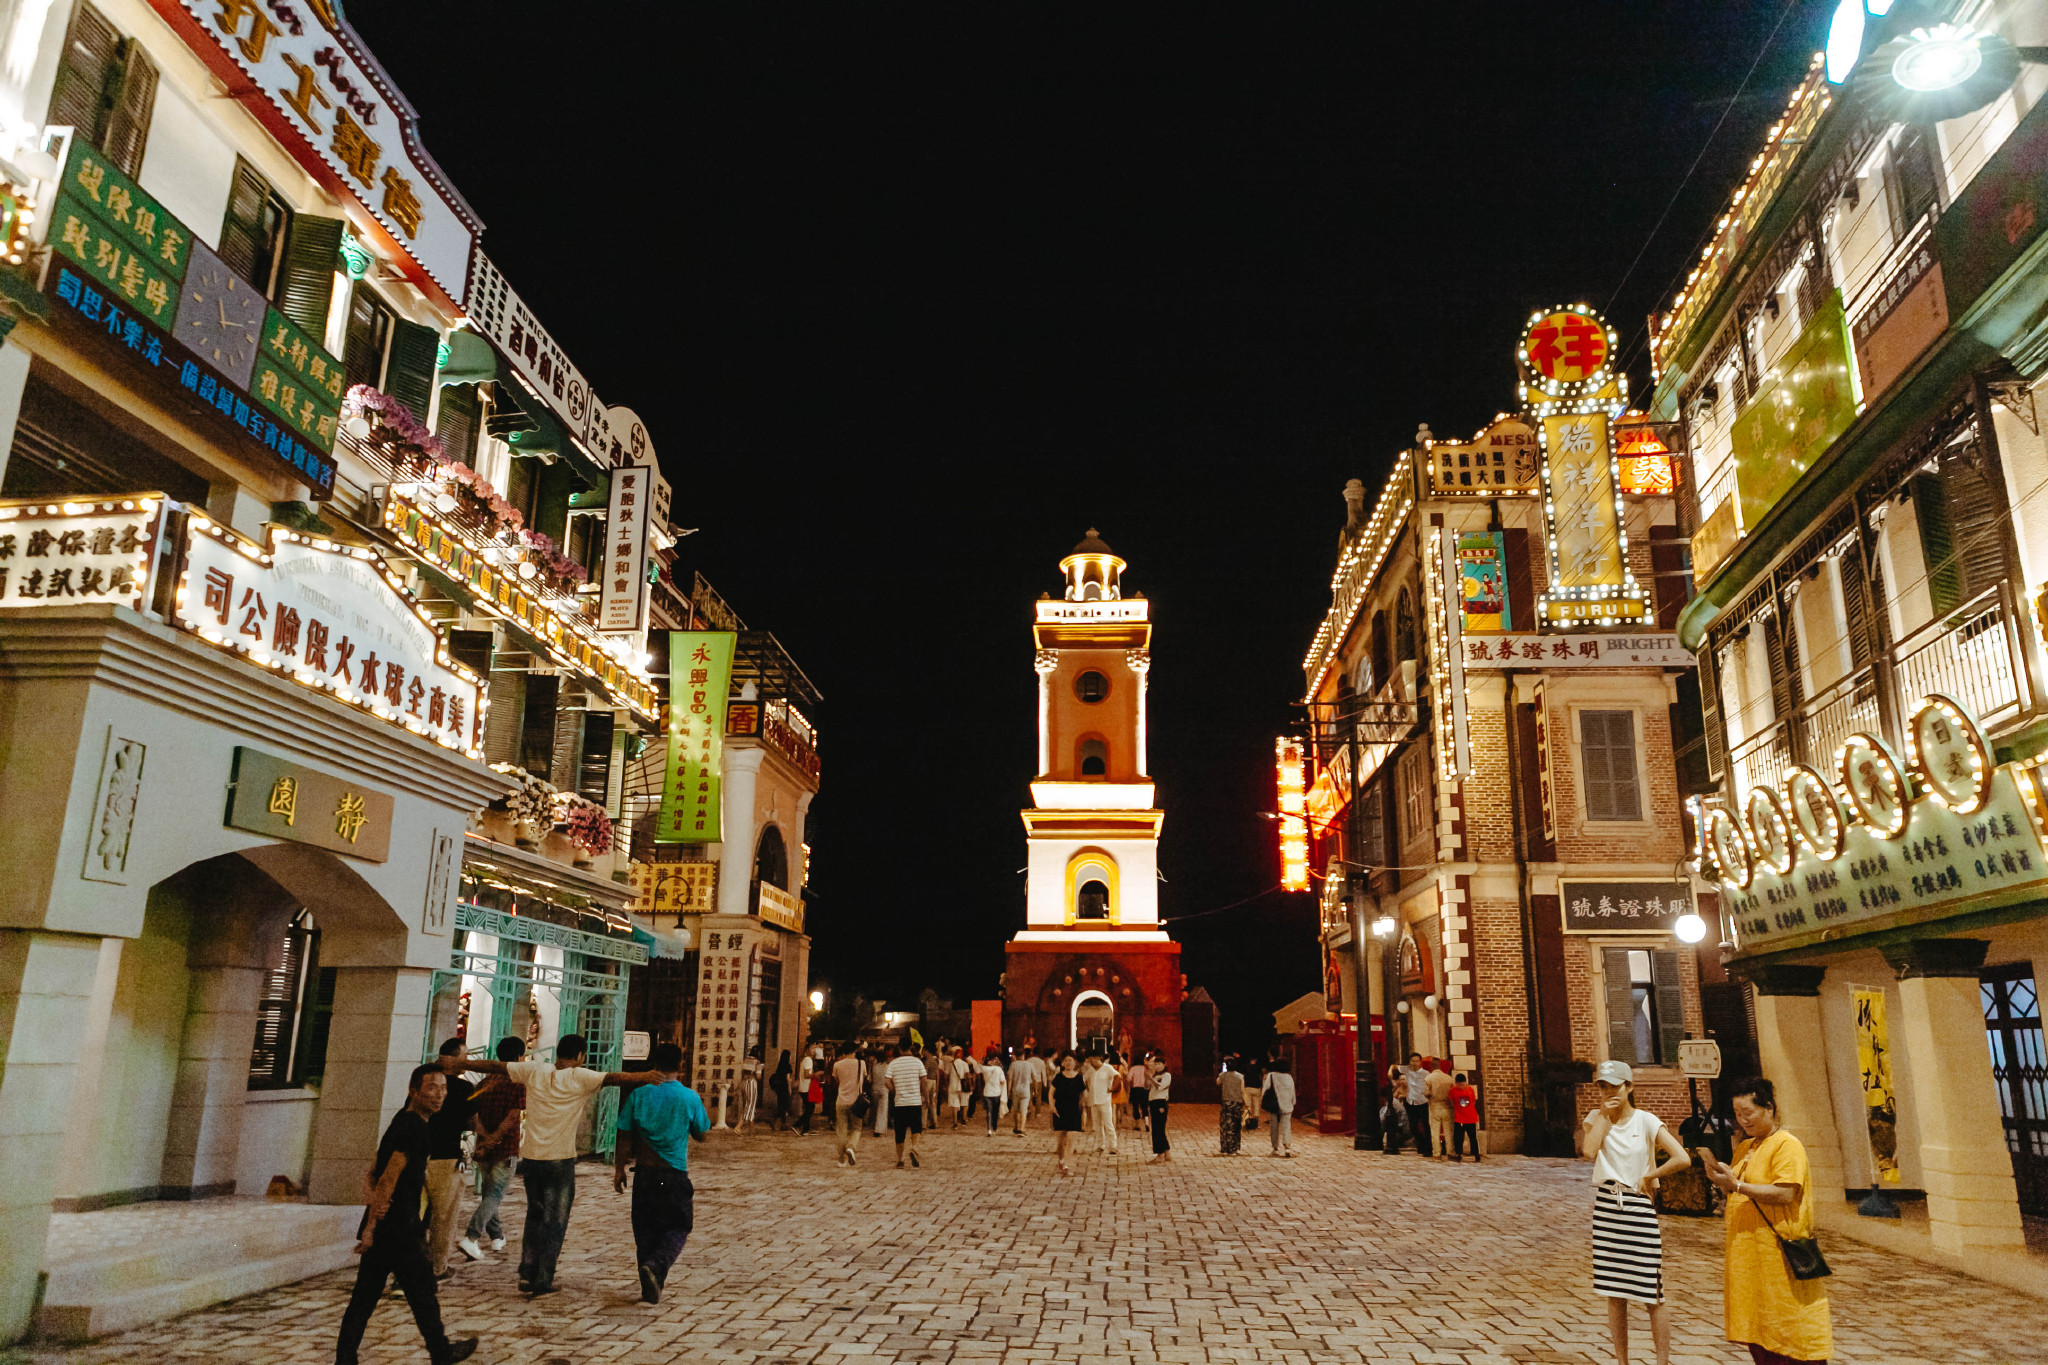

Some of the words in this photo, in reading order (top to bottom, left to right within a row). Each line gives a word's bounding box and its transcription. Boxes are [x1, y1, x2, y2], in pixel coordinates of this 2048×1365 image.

[550, 343, 572, 375] BEER
[1528, 315, 1605, 379] 祥
[1559, 422, 1609, 580] 瑞祥洋行
[1560, 604, 1629, 618] FURUI
[1607, 637, 1675, 650] BRIGHT
[688, 643, 712, 713] 永興昌
